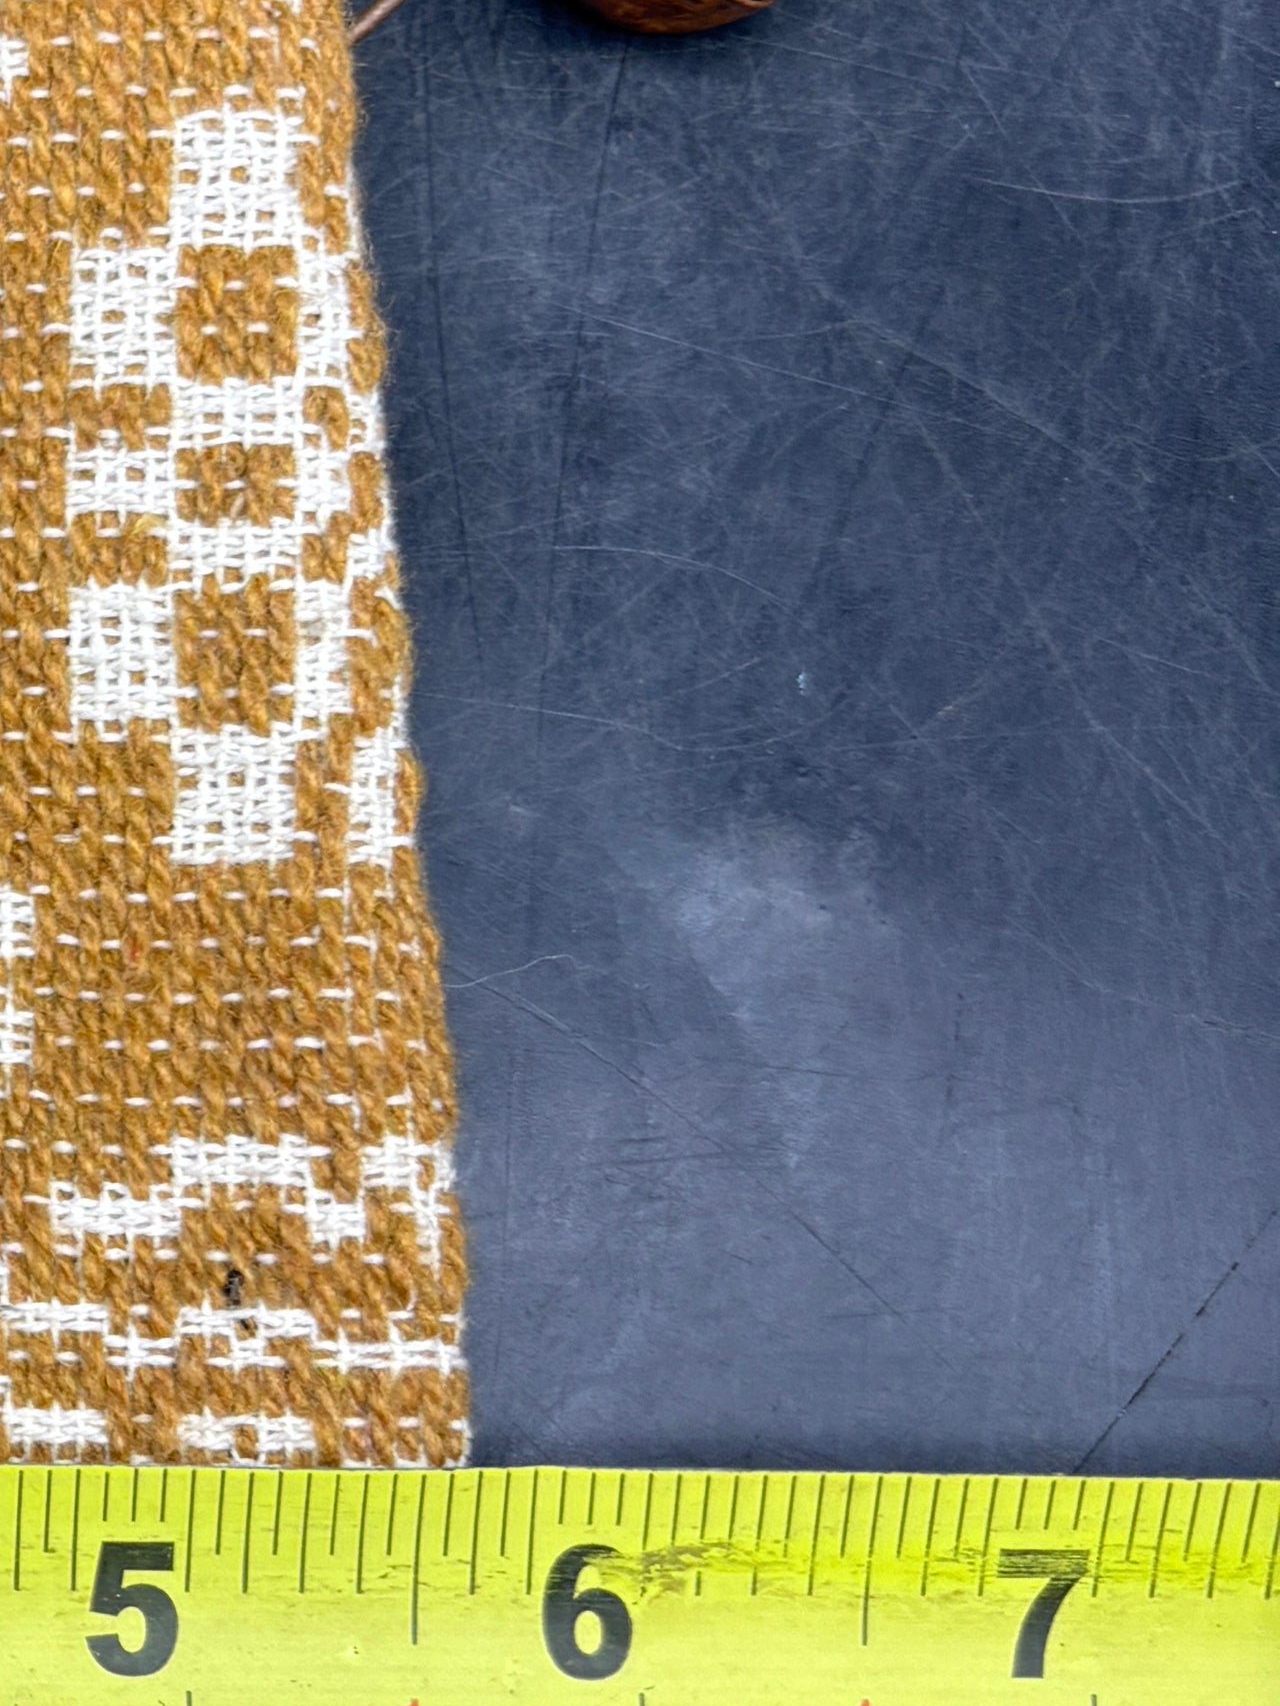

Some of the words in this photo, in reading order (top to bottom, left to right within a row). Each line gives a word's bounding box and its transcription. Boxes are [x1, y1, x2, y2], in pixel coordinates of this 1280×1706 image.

[86, 1541, 179, 1676] 5
[542, 1543, 633, 1680] 6
[997, 1549, 1090, 1678] 7
